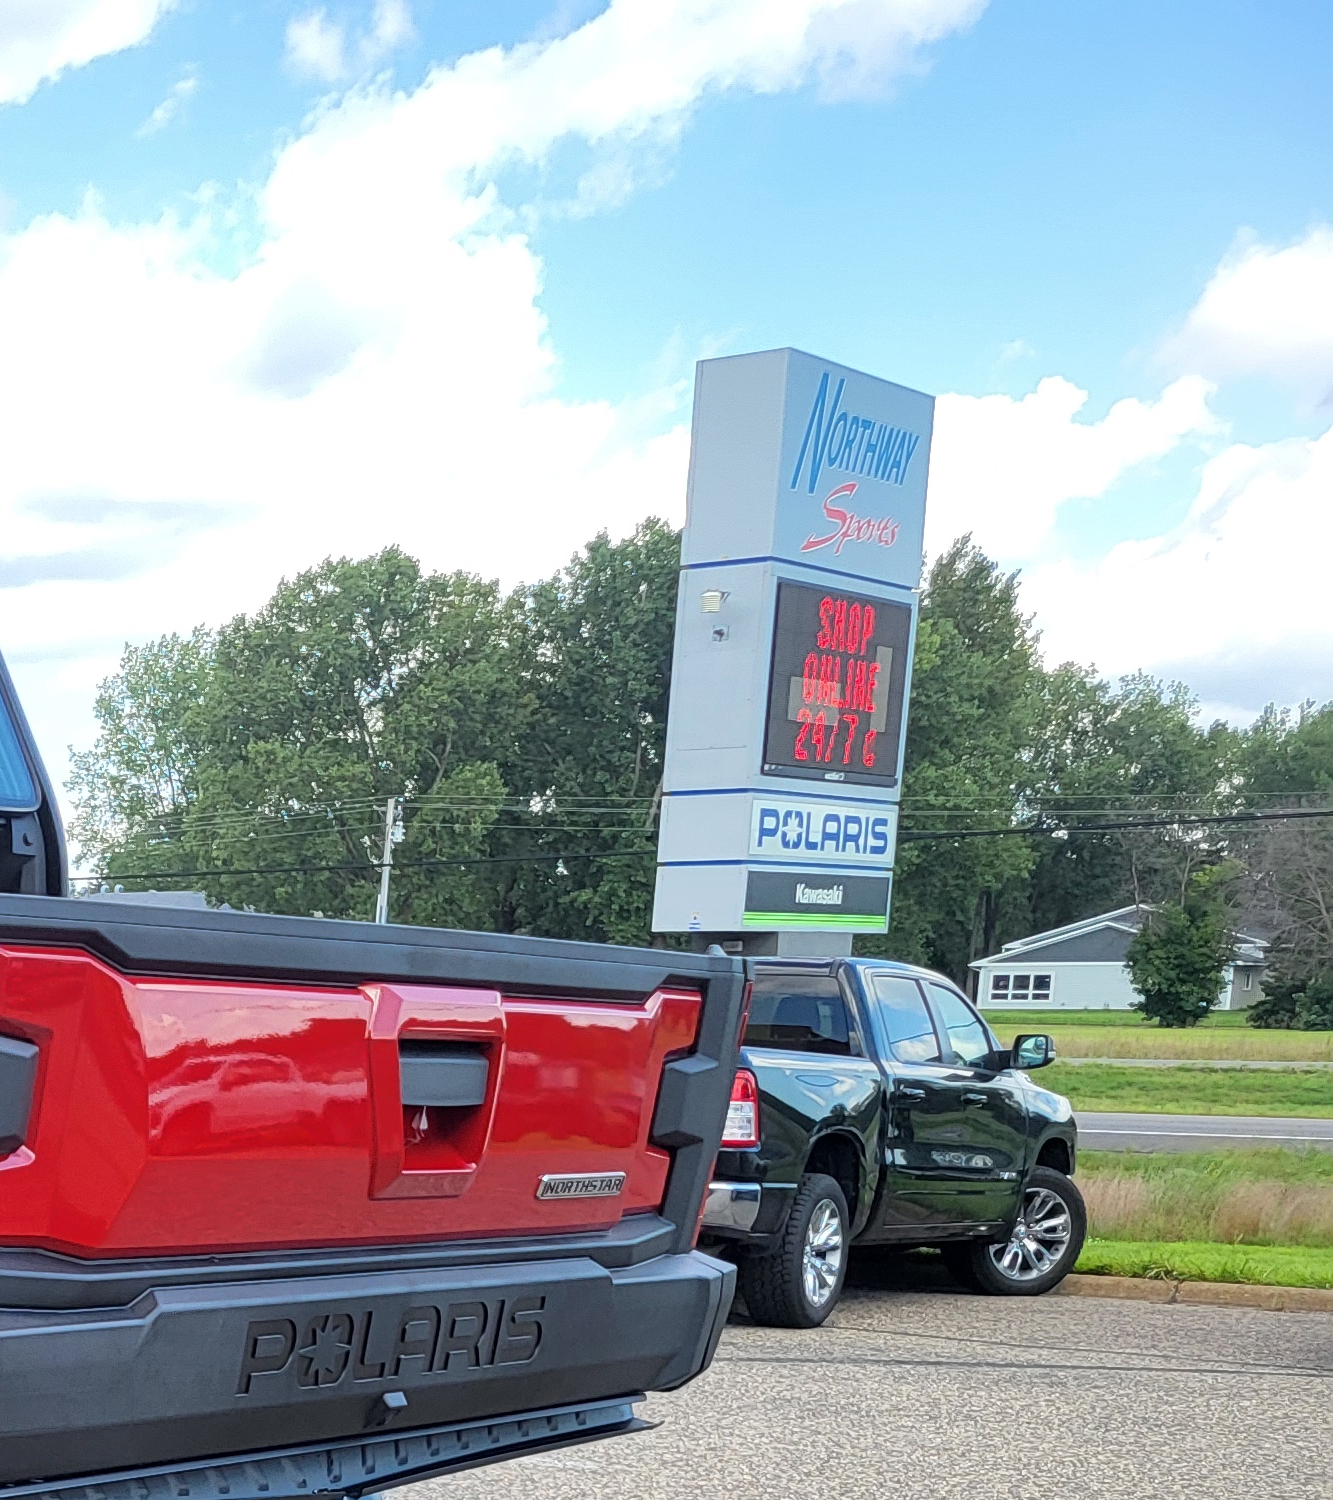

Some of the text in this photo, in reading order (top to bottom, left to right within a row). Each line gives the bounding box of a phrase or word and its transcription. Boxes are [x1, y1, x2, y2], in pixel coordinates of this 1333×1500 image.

[801, 482, 900, 555] Sports
[817, 595, 875, 655] SHOP
[802, 652, 881, 712] ONLINE
[795, 708, 859, 765] 24/7
[757, 807, 889, 855] POLARIS
[795, 882, 844, 905] Kawasaki
[545, 1178, 622, 1195] NORTHSTAR
[234, 1295, 548, 1398] POLARIS
